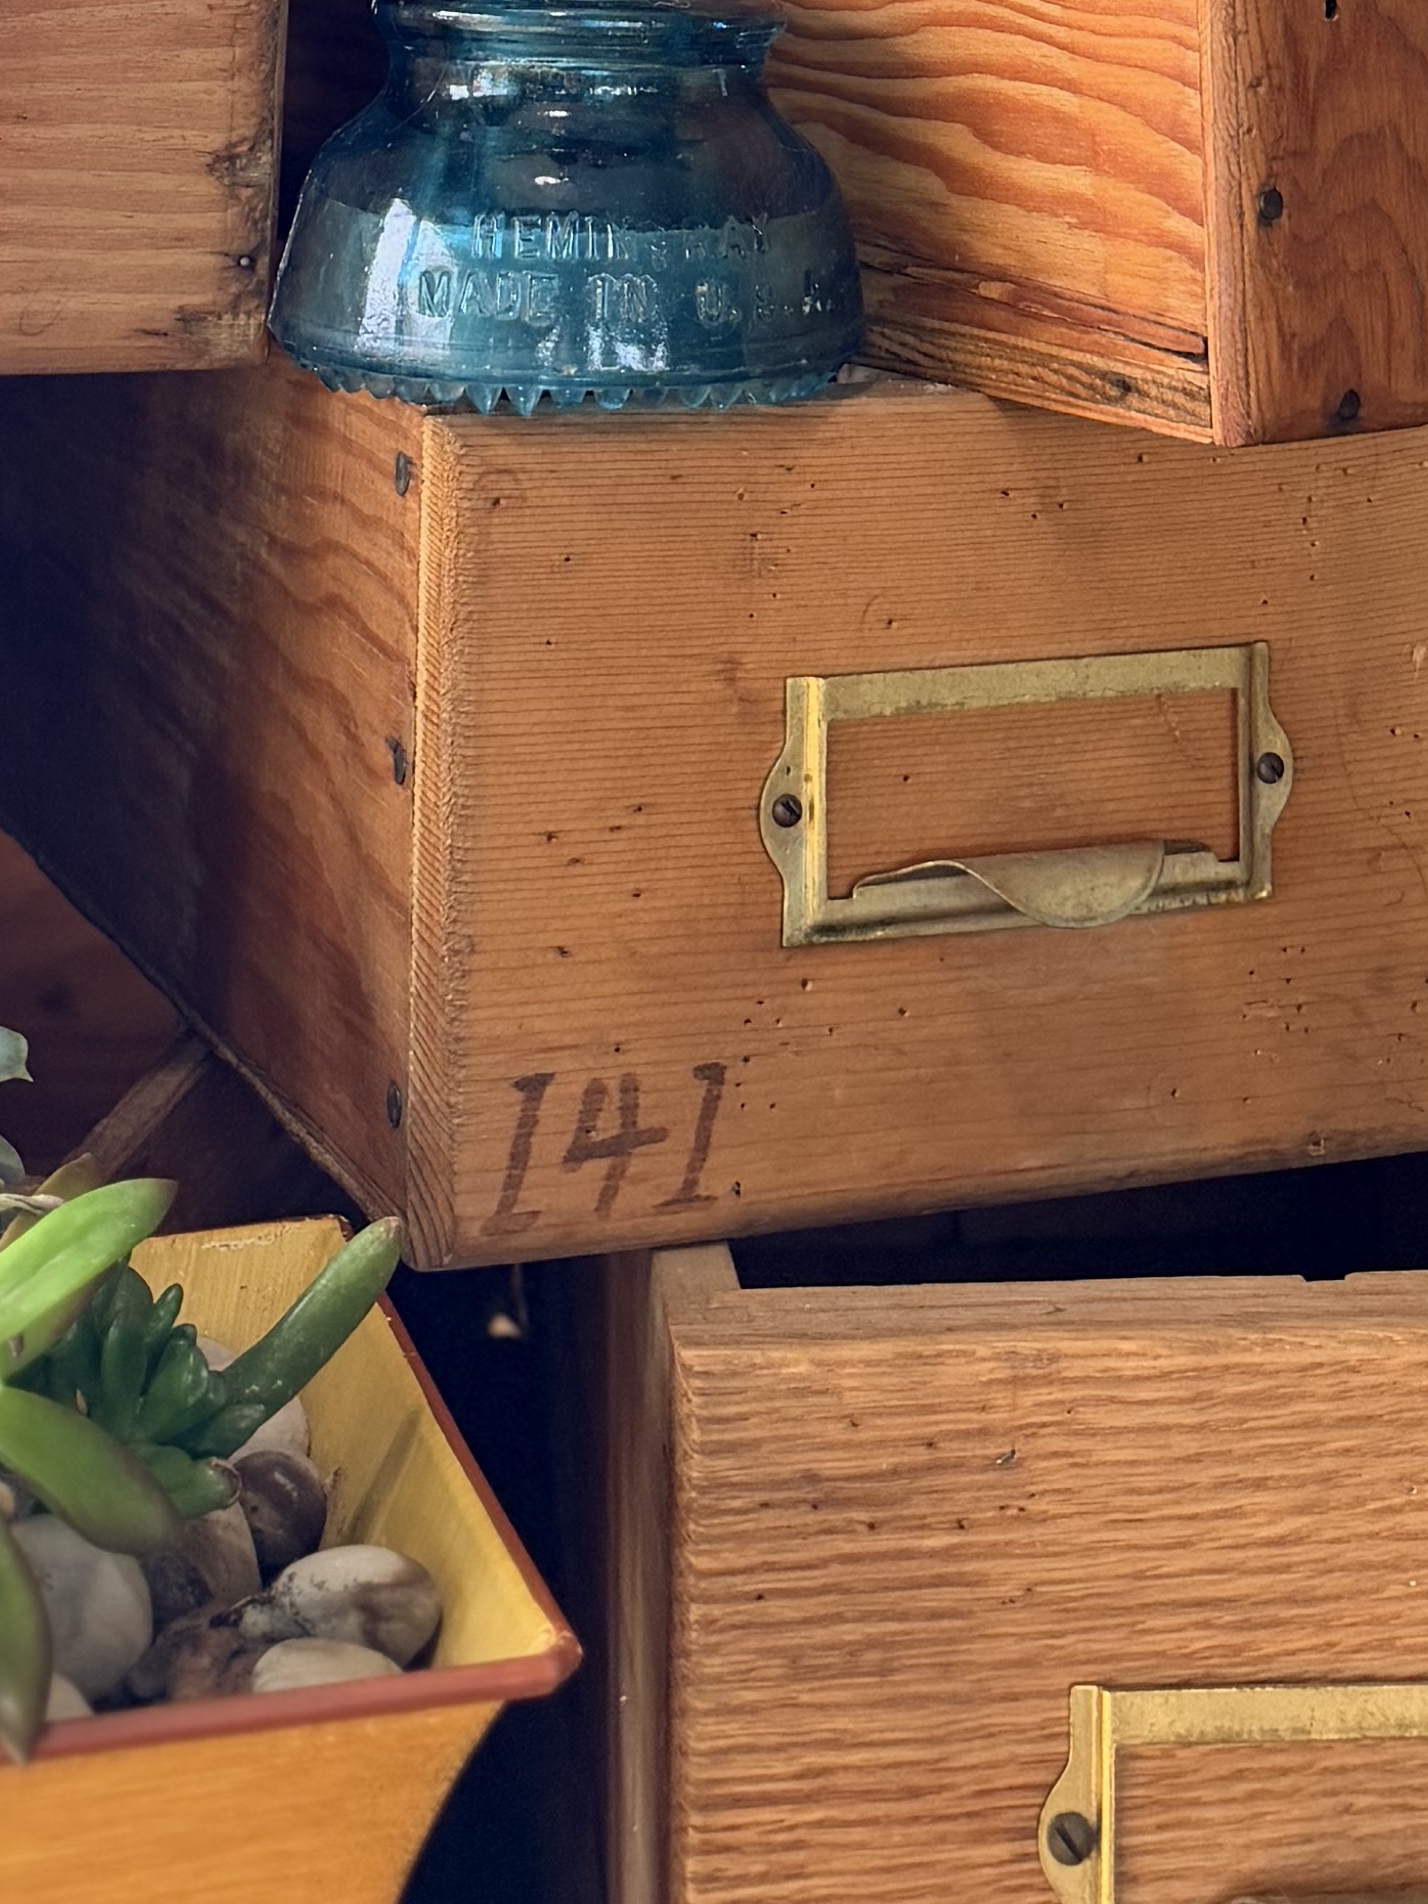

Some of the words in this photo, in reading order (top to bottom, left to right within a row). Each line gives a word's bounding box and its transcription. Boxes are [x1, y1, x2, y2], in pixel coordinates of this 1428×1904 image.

[416, 268, 560, 326] MADE
[585, 272, 660, 324] IN
[480, 1061, 728, 1236] 141
